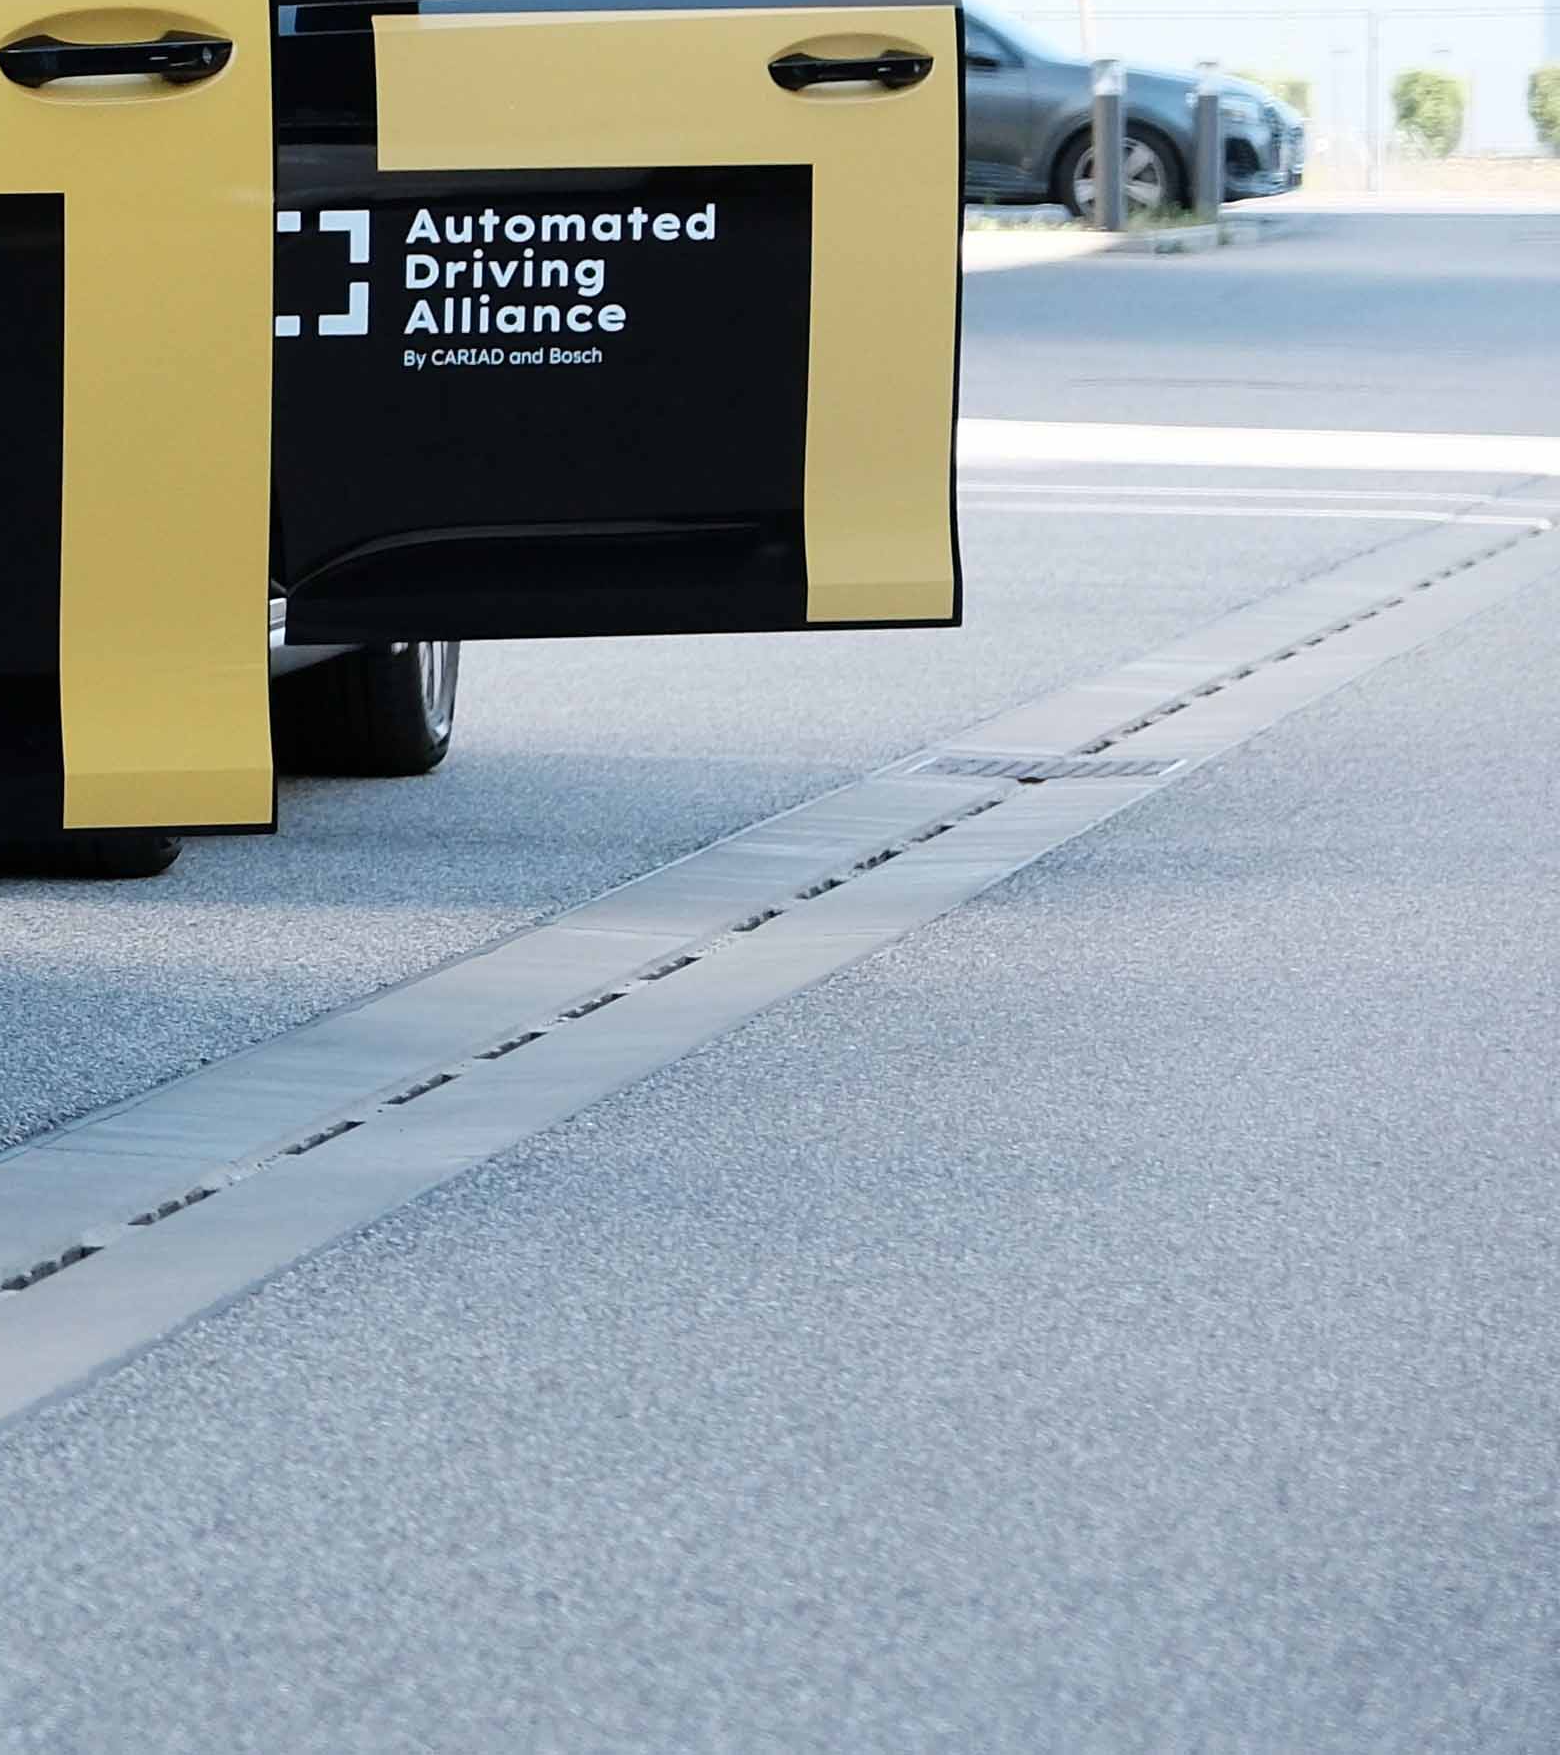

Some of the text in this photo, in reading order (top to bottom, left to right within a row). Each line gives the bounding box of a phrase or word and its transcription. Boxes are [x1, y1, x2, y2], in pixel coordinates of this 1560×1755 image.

[406, 203, 716, 244] Automated
[405, 248, 606, 297] Driving
[404, 294, 627, 335] Alliance
[403, 346, 604, 371] By CARIAD and Bosch
